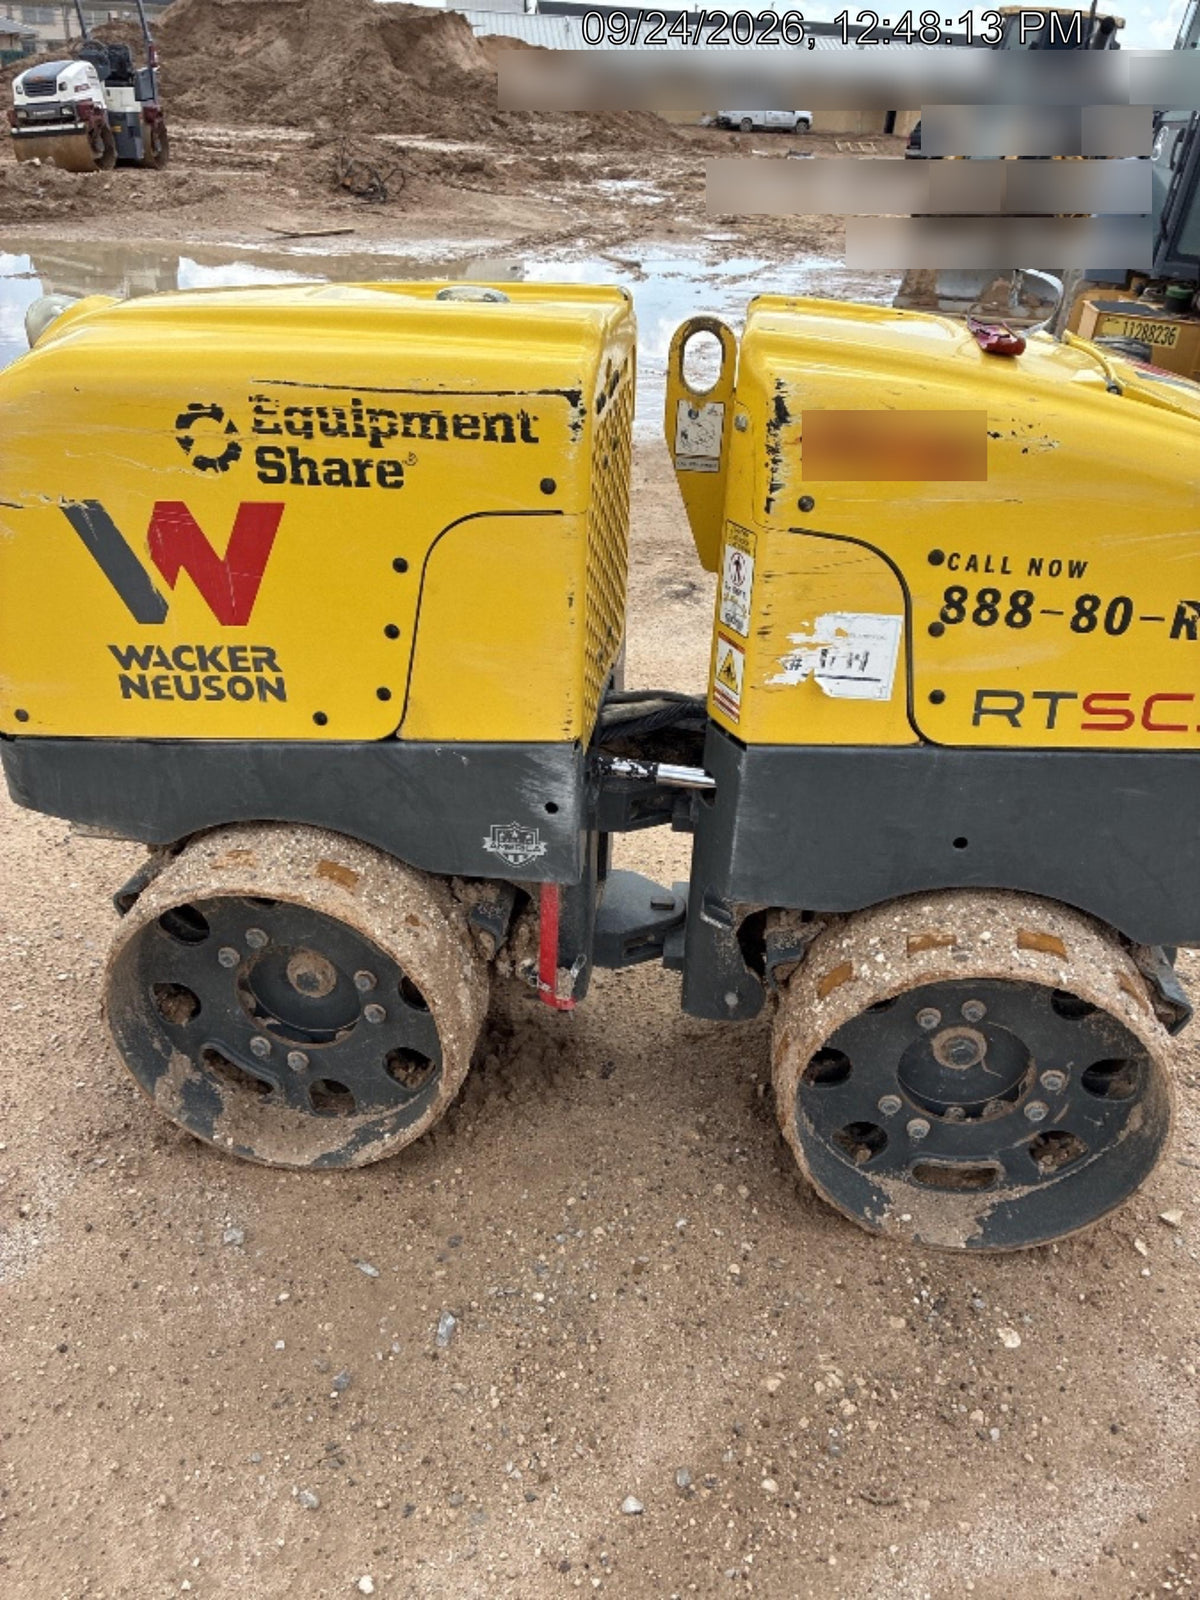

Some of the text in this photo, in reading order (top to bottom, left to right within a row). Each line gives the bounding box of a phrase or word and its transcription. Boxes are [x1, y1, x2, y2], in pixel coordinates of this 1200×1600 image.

[1122, 320, 1177, 346] 11288236
[249, 394, 539, 448] Equipment
[948, 553, 1089, 579] CALL NOW
[108, 645, 282, 672] WACKER
[119, 674, 286, 702] NEUSON
[971, 690, 1200, 732] RTSC
